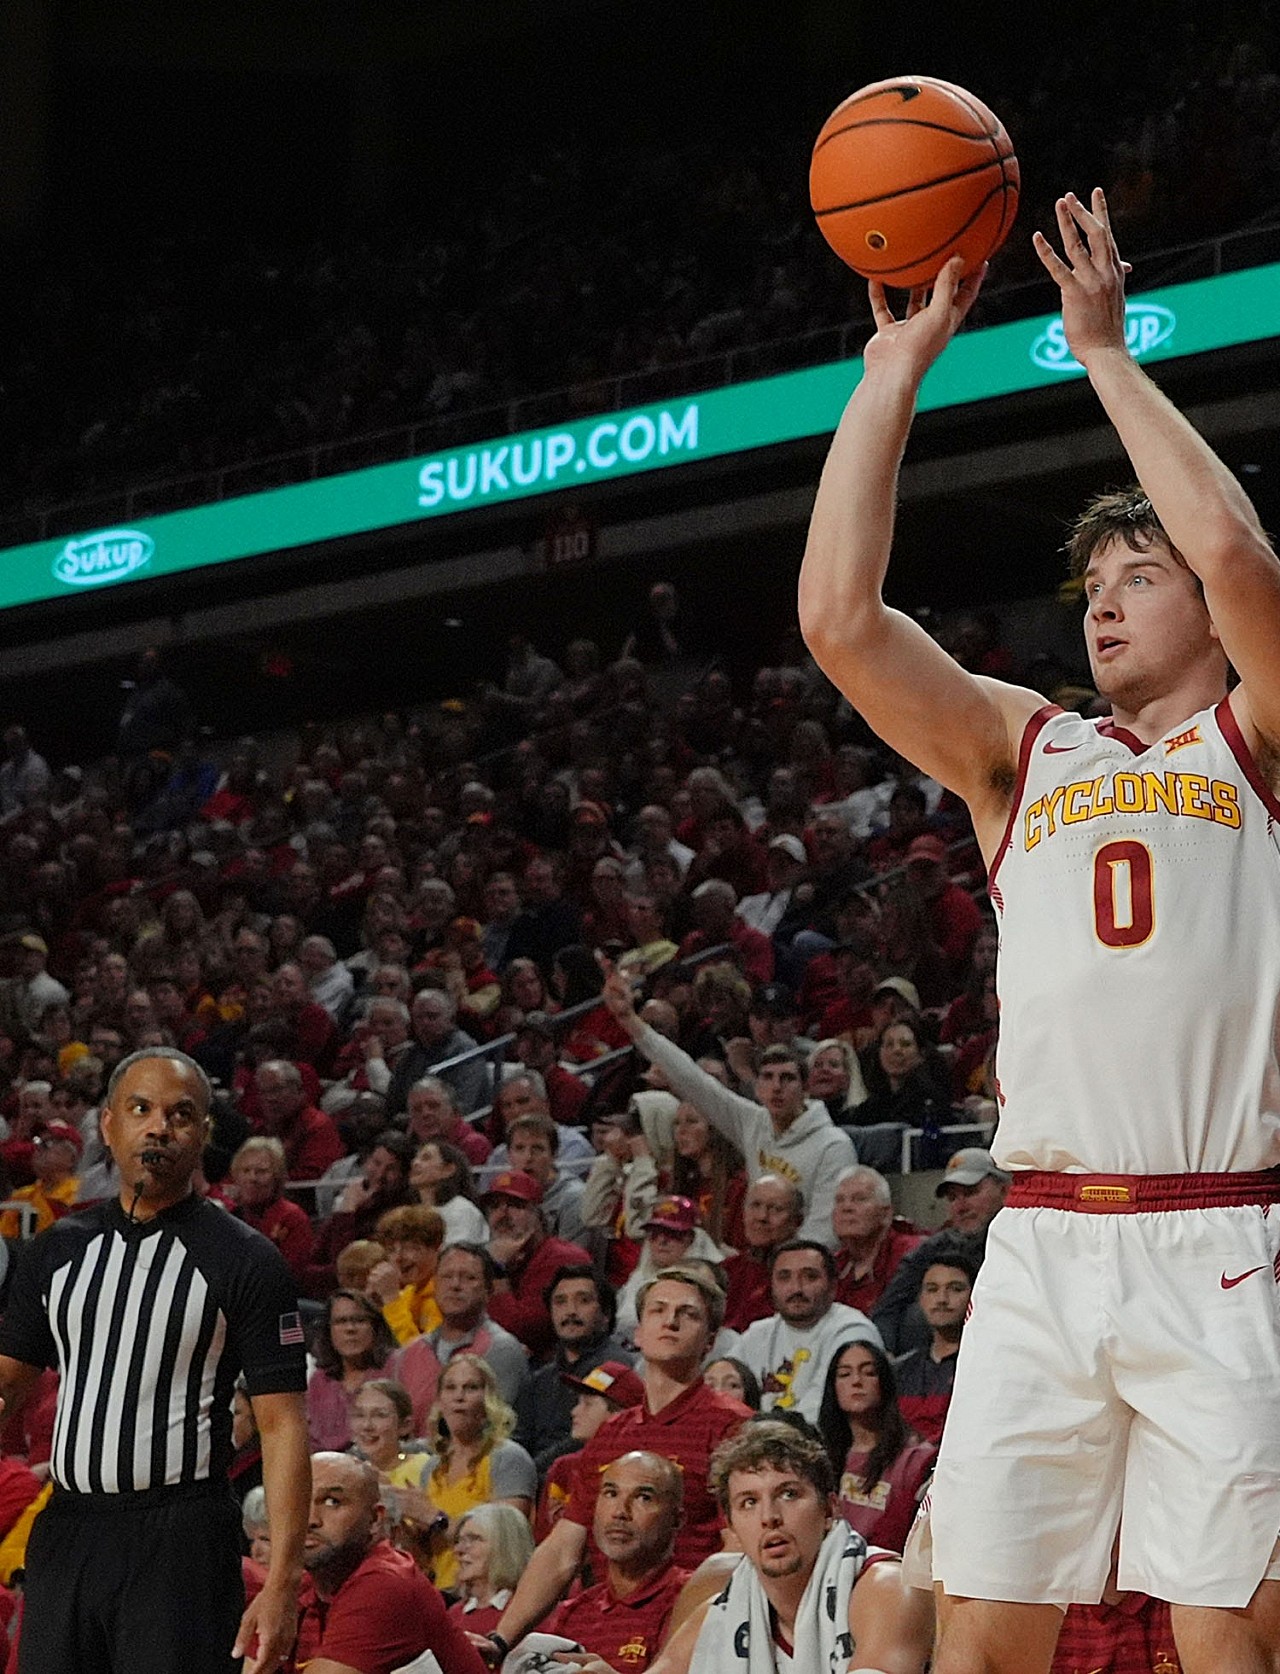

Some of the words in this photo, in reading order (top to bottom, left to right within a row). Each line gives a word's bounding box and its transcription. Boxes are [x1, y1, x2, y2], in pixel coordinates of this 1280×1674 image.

[1045, 314, 1161, 361] Sup
[418, 403, 699, 507] SUKUP.COM
[63, 540, 144, 577] Sukup
[1024, 770, 1242, 852] CYCLONES
[1092, 838, 1156, 949] 0
